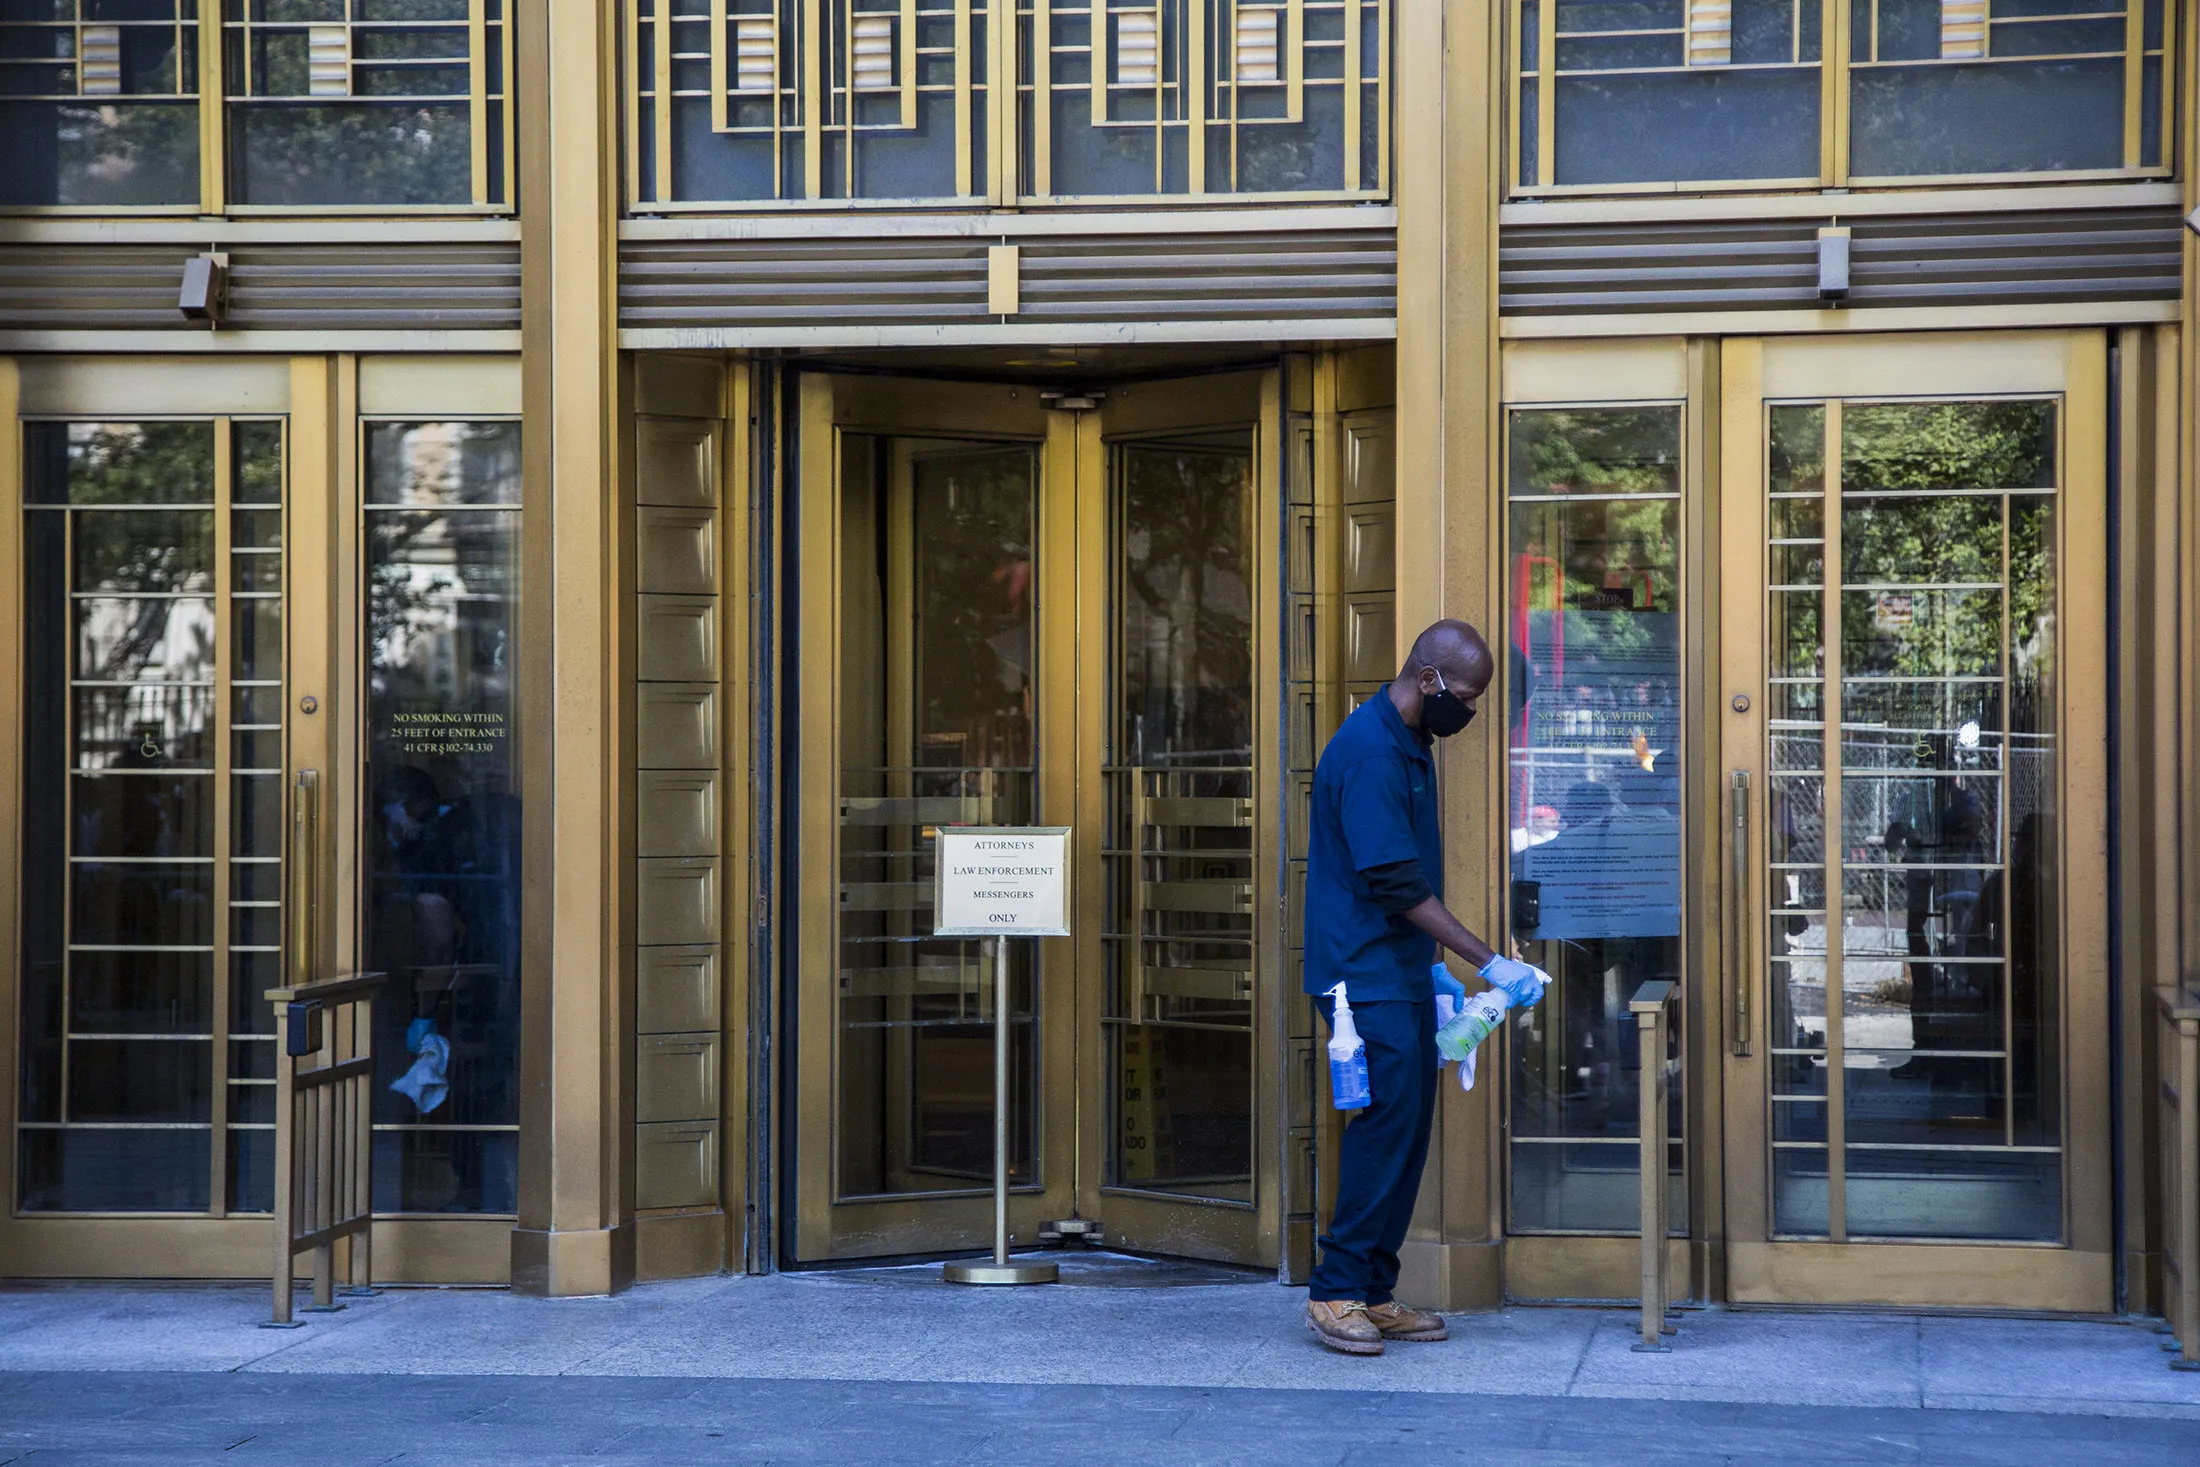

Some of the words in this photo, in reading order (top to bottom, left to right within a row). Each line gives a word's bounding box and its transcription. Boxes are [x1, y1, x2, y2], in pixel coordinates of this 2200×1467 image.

[393, 713, 409, 723] NO
[411, 713, 461, 723] SMOKING
[463, 713, 503, 723] WITHIN
[1537, 711, 1554, 721] NO
[1611, 711, 1654, 721] WITHIN
[390, 728, 402, 738] 25
[404, 728, 429, 738] FEET
[431, 728, 446, 738] OF
[448, 728, 505, 738] ENTRANCE
[403, 743, 414, 752] 41
[974, 841, 1035, 850] ATTORNEYS
[953, 866, 976, 876] LAW
[978, 866, 1055, 876] ENFORCEMENT
[973, 890, 1034, 899] MESSENGERS
[988, 913, 1018, 923] ONLY
